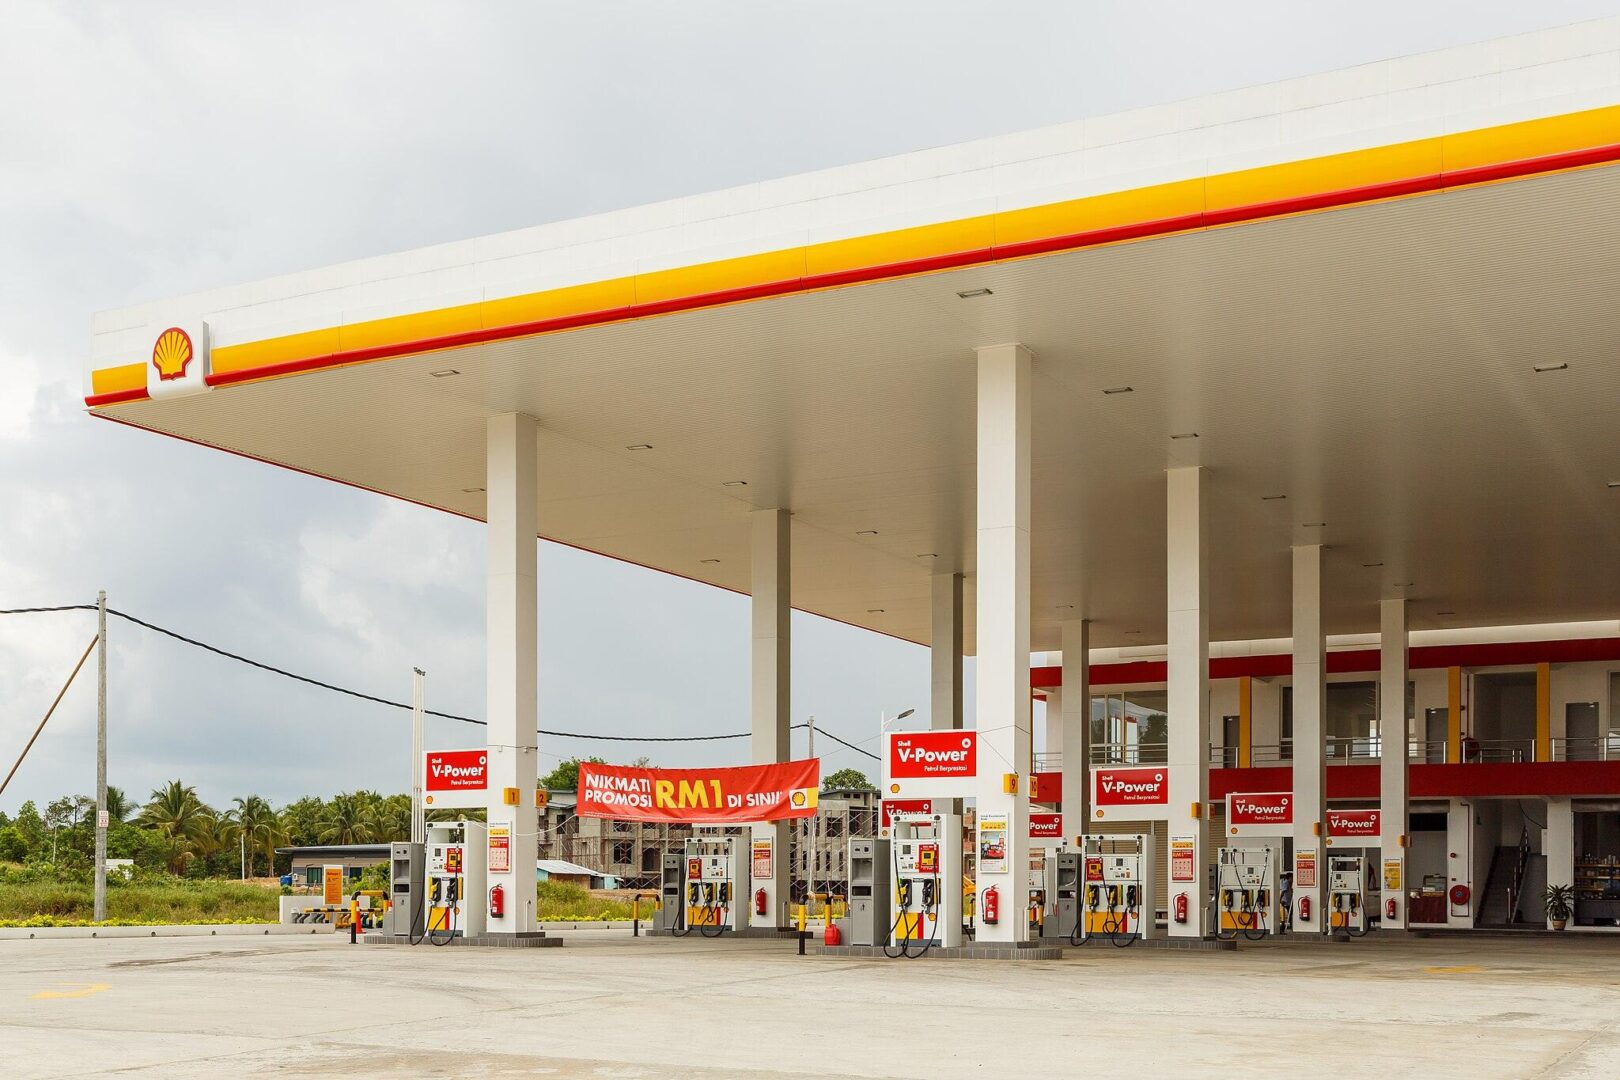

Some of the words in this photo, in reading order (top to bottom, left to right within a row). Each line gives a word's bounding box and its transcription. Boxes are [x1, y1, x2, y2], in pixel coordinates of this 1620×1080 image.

[897, 747, 968, 763] V-Power
[431, 764, 484, 778] V-Power
[585, 773, 651, 793] NIKMATI
[1011, 777, 1016, 790] 9
[1102, 781, 1160, 793] V-Power
[511, 792, 515, 802] 1
[539, 793, 545, 803] 2
[584, 789, 653, 808] PROMOSI
[655, 779, 723, 809] RM1
[727, 794, 742, 808] DI
[1236, 804, 1286, 815] V-Power
[1029, 821, 1058, 830] Power
[1331, 819, 1375, 829] V-Power
